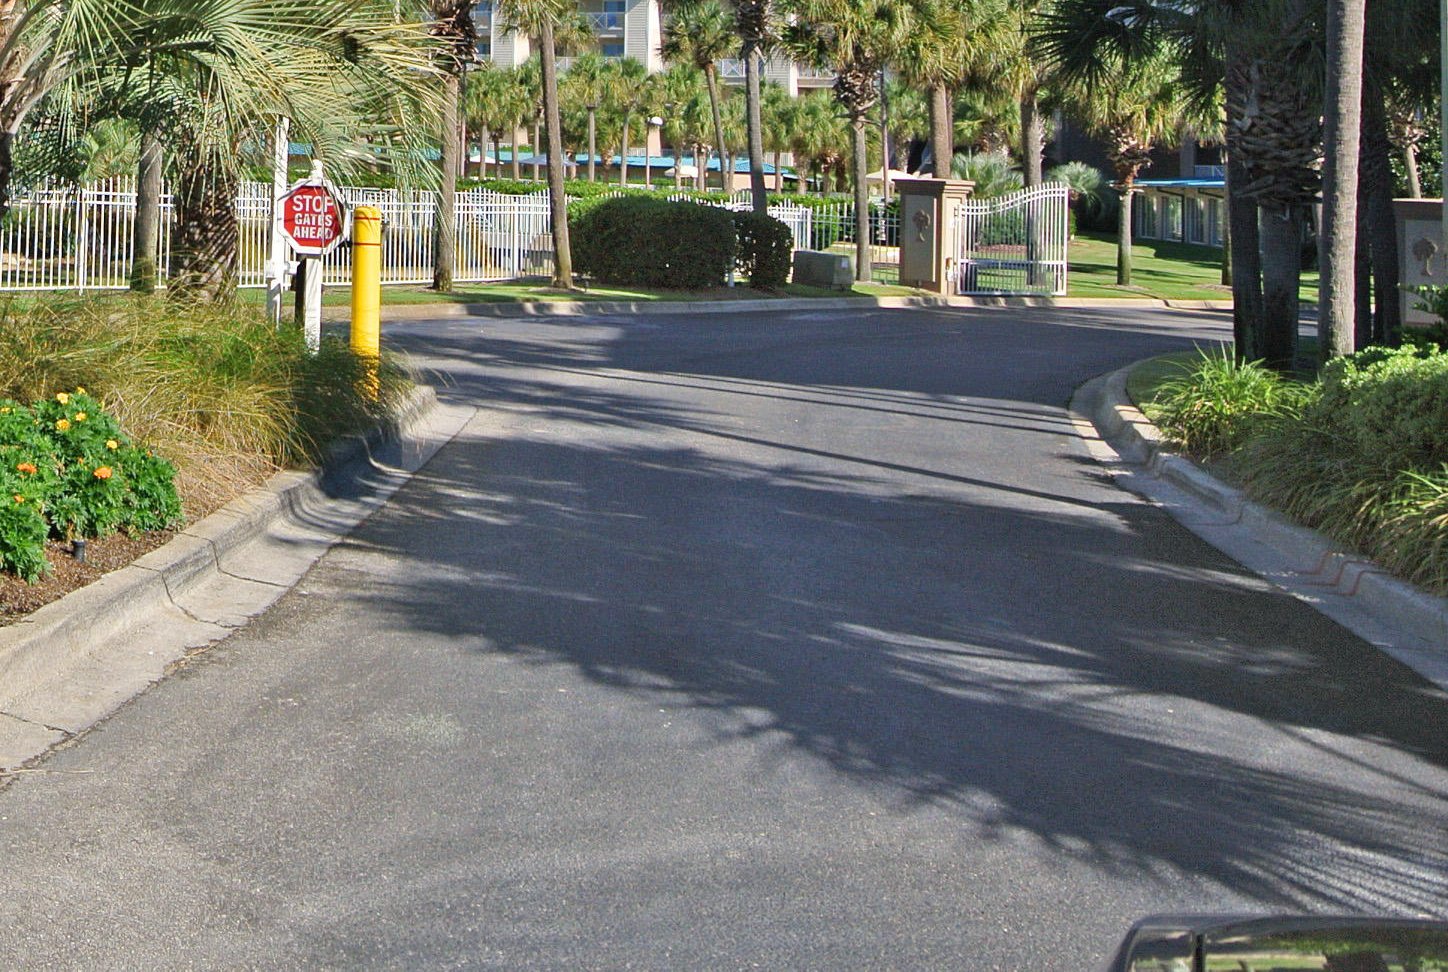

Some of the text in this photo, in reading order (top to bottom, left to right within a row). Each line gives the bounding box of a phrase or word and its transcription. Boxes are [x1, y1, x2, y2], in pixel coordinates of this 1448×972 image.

[292, 195, 334, 213] STOP
[294, 213, 333, 227] GATES
[293, 226, 333, 240] AHEAD
